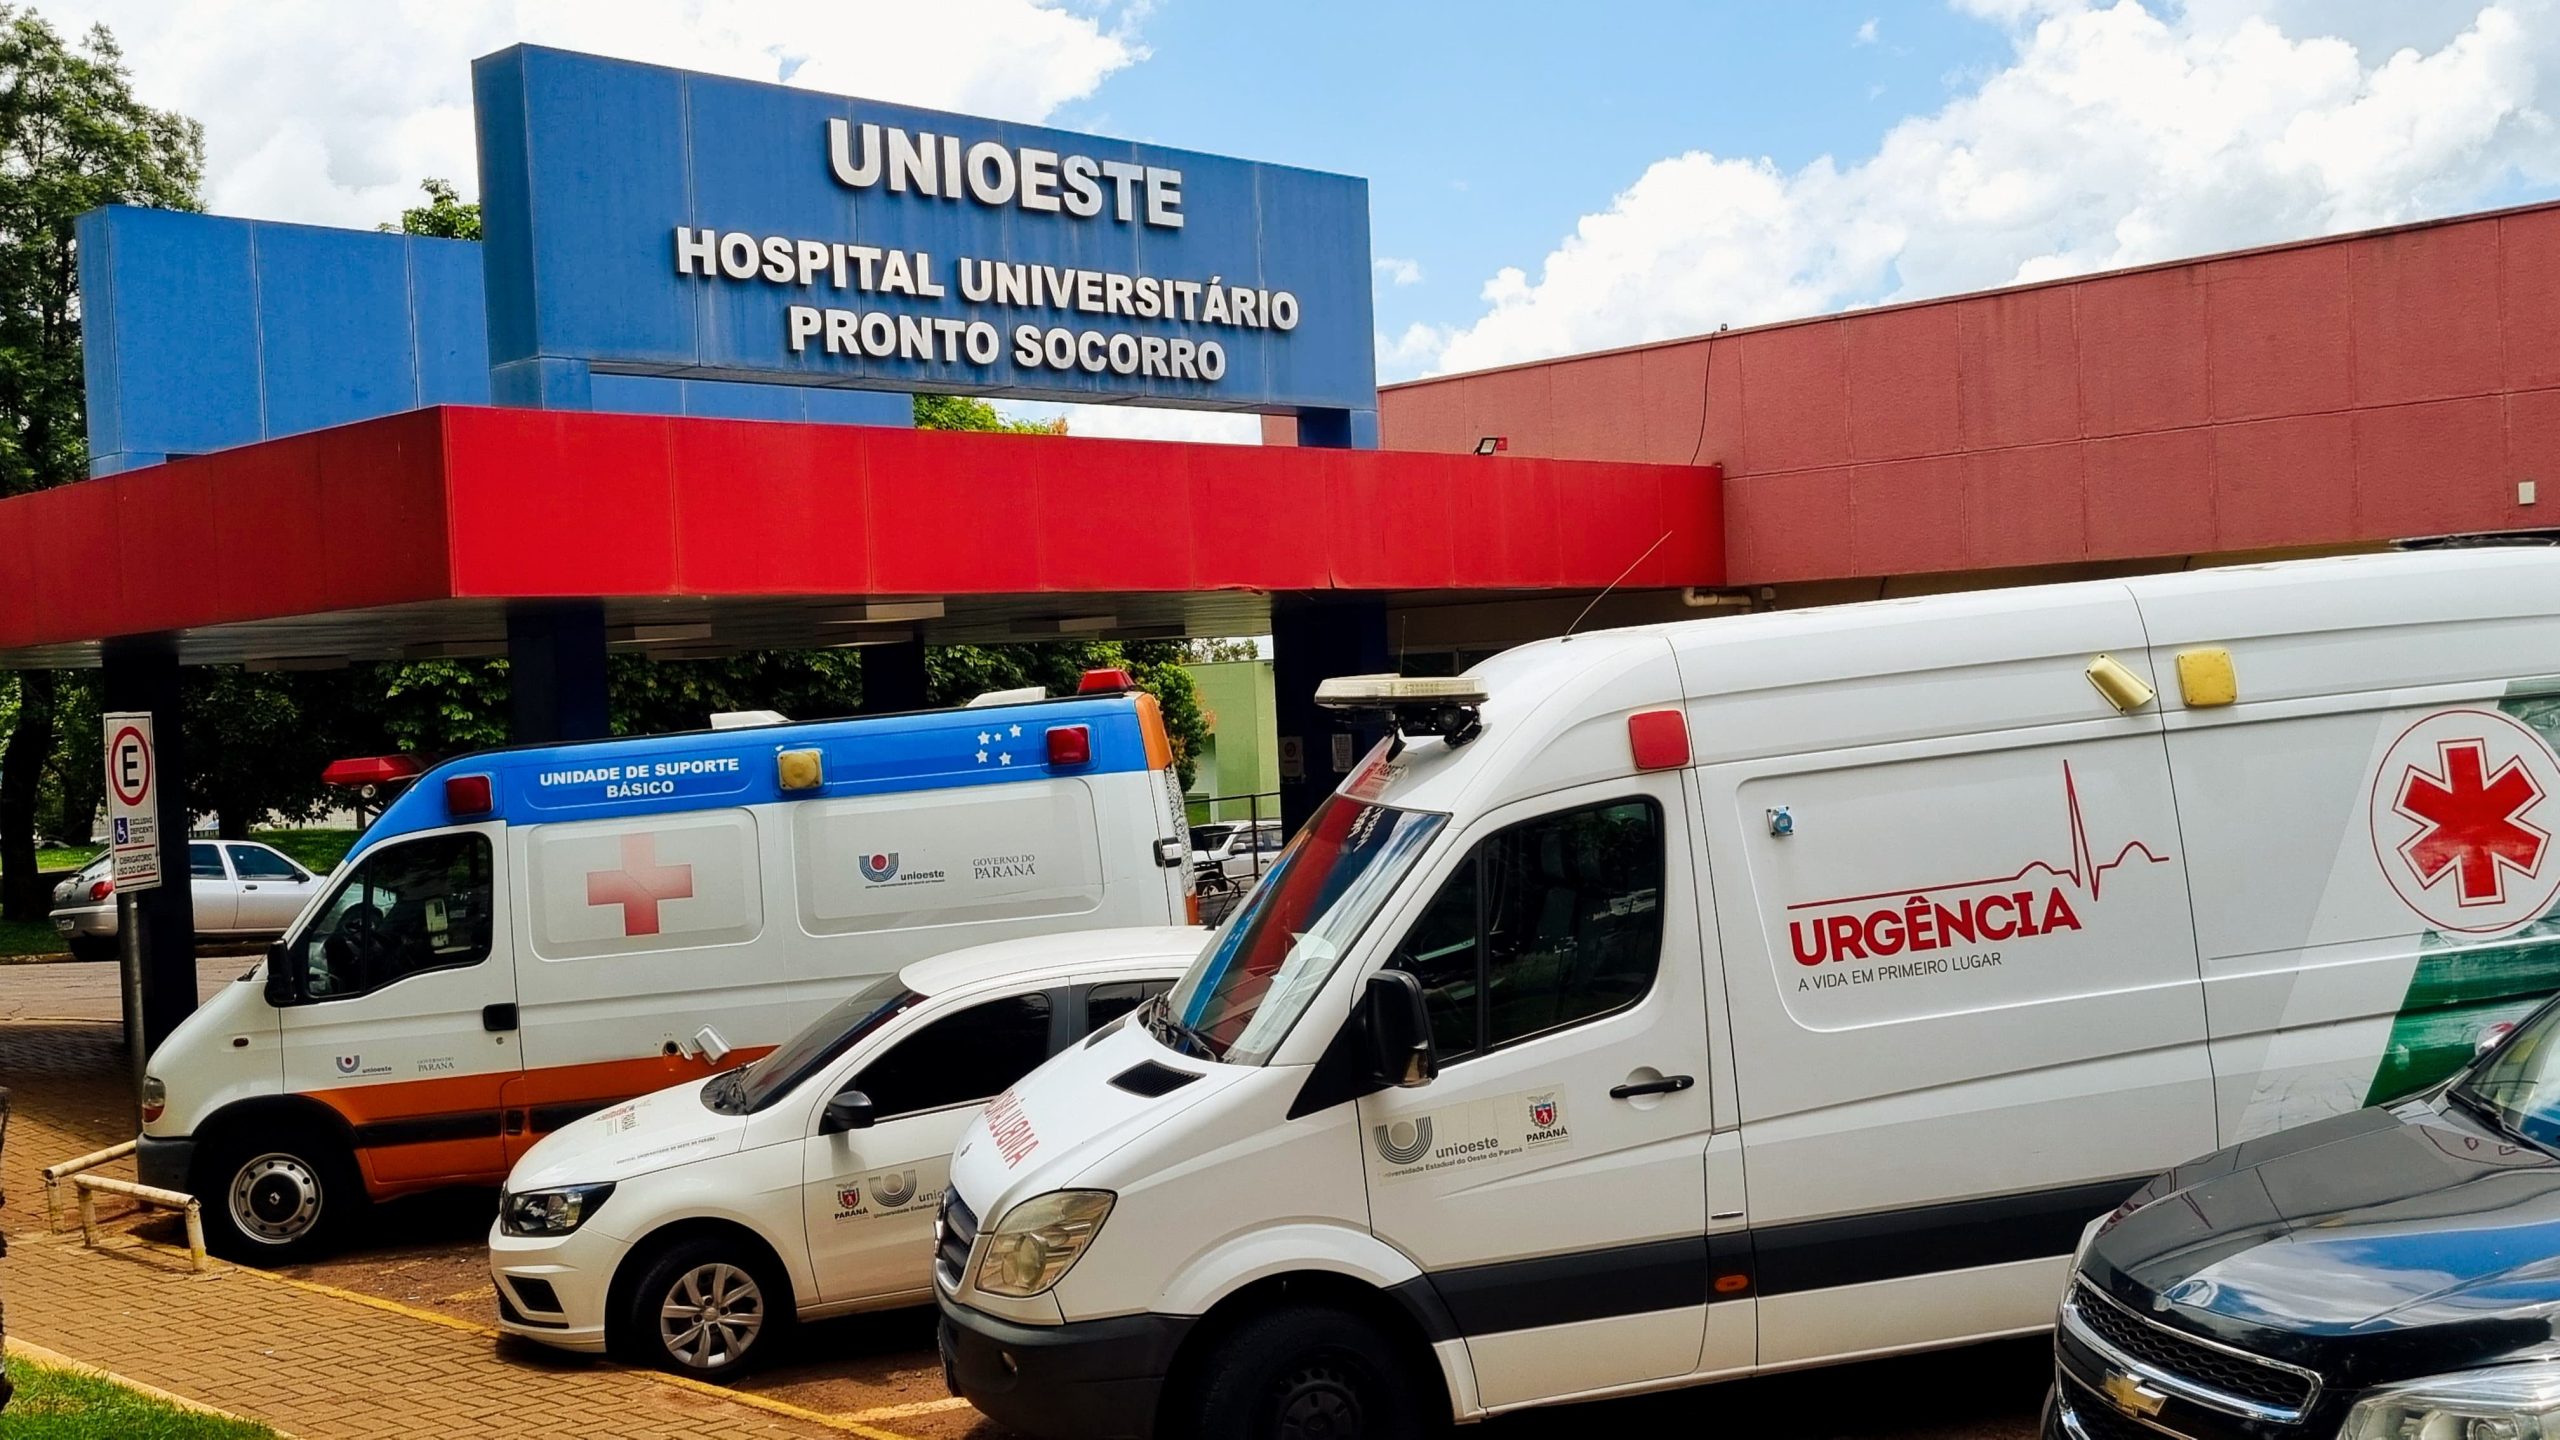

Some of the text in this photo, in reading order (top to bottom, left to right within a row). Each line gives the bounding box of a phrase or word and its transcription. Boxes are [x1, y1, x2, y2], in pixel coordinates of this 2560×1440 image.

[827, 118, 1184, 228] UNIOESTE
[675, 226, 1299, 331] HOSPITAL UNIVERSITÁRIO
[788, 305, 1226, 382] PRONTO SOCORRO
[122, 745, 140, 788] E
[540, 758, 740, 786] UNIDADE DE SUPORTE
[606, 781, 674, 798] BÁSICO
[973, 854, 1036, 867] GOVERNO DO
[974, 863, 1036, 880] PARANÁ
[900, 870, 945, 881] unioeste
[1789, 886, 2082, 967] URGÊNCIA
[1798, 952, 2003, 992] A VIDA EM PRIMEIRO LUGAR
[1526, 1125, 1568, 1143] PARANÁ
[1426, 1159, 1455, 1171] Estadual
[1457, 1157, 1466, 1165] do
[1467, 1154, 1487, 1163] Oeste
[1488, 1151, 1498, 1159] do
[1499, 1146, 1523, 1157] Paraná
[1435, 1137, 1499, 1159] unioeste
[919, 1189, 945, 1202] unio
[834, 1207, 868, 1219] PARANÁ
